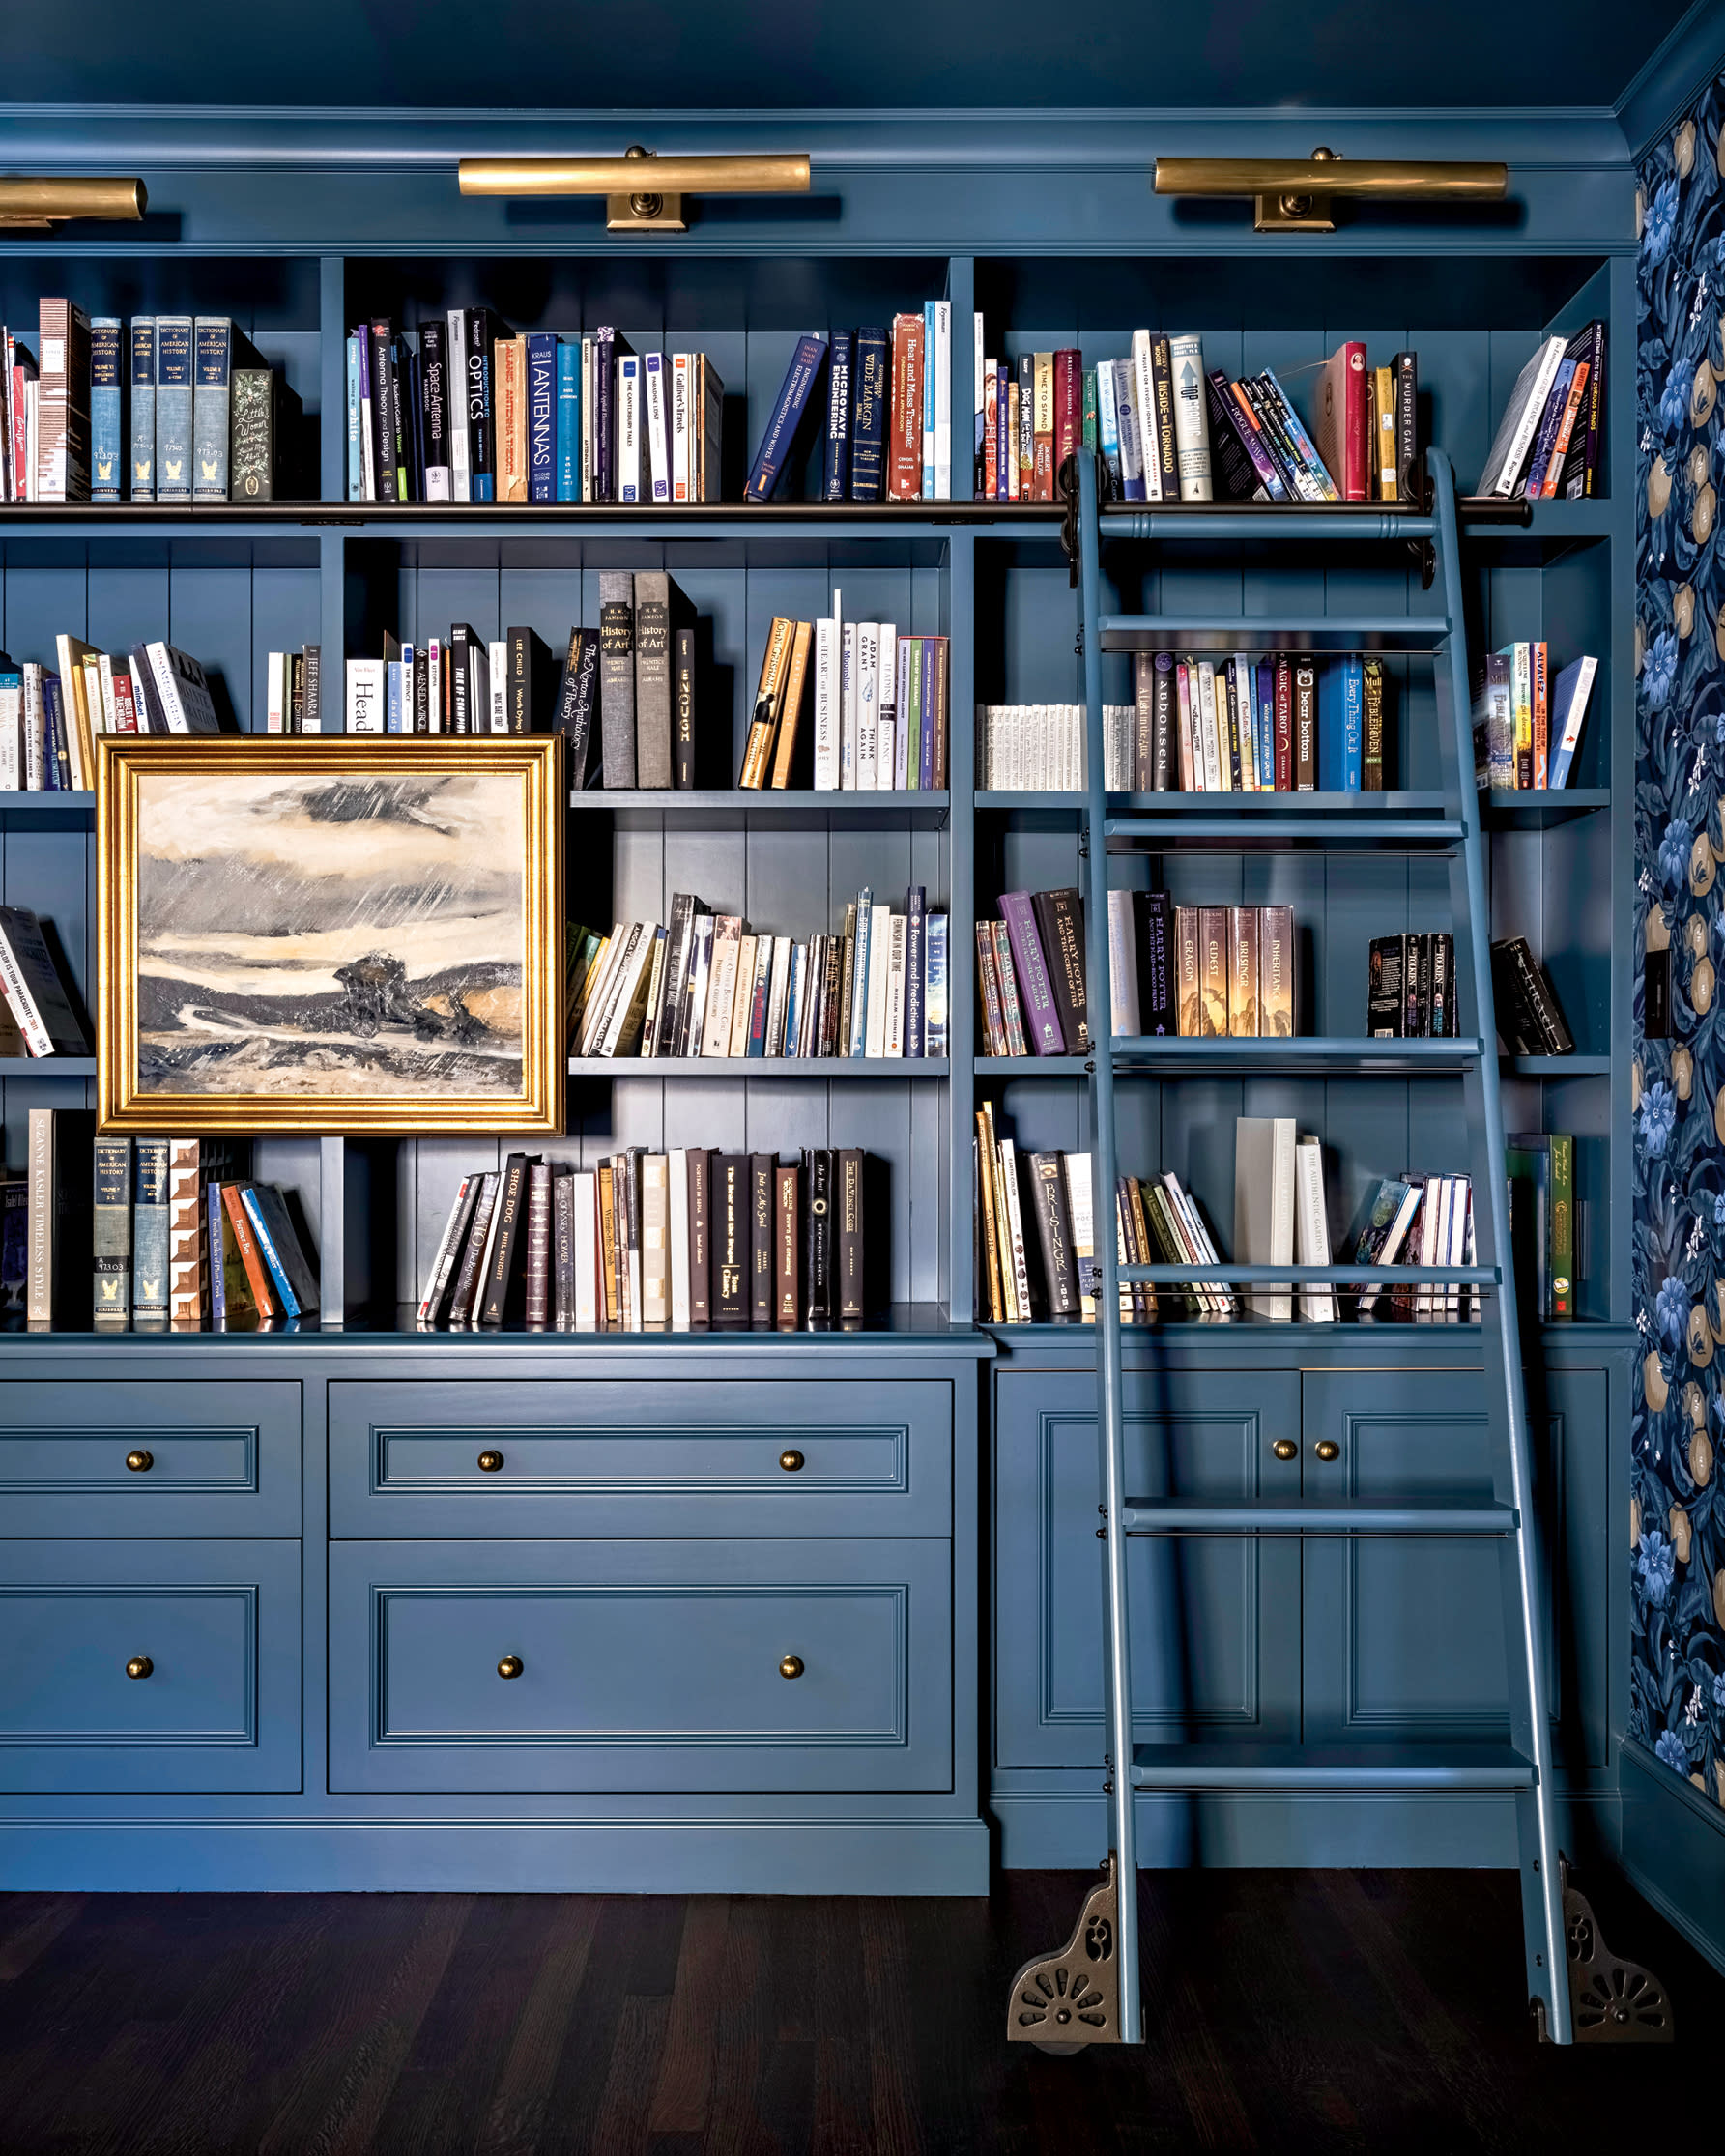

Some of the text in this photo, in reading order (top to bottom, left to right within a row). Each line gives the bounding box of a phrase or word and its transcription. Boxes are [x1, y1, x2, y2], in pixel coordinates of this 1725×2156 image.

[378, 346, 388, 385] Antenna
[532, 350, 552, 359] KRAUS
[427, 362, 443, 393] Space
[469, 355, 484, 420] OPTICS
[791, 367, 812, 409] ENGINEERING
[862, 353, 875, 431] WIDE MARGIN
[905, 338, 917, 448] Heat and Mass Transfer
[1157, 380, 1170, 414] INSIDE
[1576, 367, 1587, 387] CURTIS
[378, 386, 388, 416] Theory
[430, 394, 444, 439] Antenna
[483, 403, 491, 417] TO
[533, 367, 550, 465] ANTENNAS
[676, 372, 685, 434] Gulliver's Travels
[764, 364, 803, 459] ELECTROMAGNETICS AND WAVES
[830, 365, 840, 439] ENGINEERING
[838, 365, 848, 439] MICROWAVE
[1144, 387, 1153, 436] REVOLUTIONARIES
[235, 419, 269, 437] Women
[381, 431, 391, 462] Design
[1231, 406, 1253, 438] ROGUE
[1248, 437, 1266, 463] WAVE
[1161, 425, 1174, 474] TORNADO
[601, 625, 632, 641] History
[602, 638, 629, 649] of Art
[638, 637, 664, 648] of Art
[764, 620, 788, 687] JOHN GRISHAM
[306, 656, 319, 716] JEFF SHAARA
[564, 677, 579, 689] of
[820, 680, 827, 690] OF
[843, 650, 851, 691] Moonshot
[1365, 676, 1382, 687] Mull
[1537, 651, 1545, 693] ALVAREZ
[134, 685, 144, 716] mindset
[355, 681, 374, 733] Head
[389, 699, 399, 730] daddy
[494, 692, 503, 728] WHAT ARE YOU?
[561, 688, 577, 720] Poetry
[570, 643, 597, 751] The Norton Anthology
[679, 668, 691, 742] ENOUGH
[819, 693, 828, 742] BUSINESS
[515, 710, 524, 730] Dying
[1300, 691, 1311, 762] bear bottom
[1367, 697, 1382, 753] FABLEHAVEN
[892, 918, 904, 942] FEMINISM
[891, 949, 903, 961] OUR
[891, 961, 903, 972] TIME
[1024, 919, 1050, 1009] HARRY POTTER
[1064, 915, 1086, 1007] HARRY POTTER
[1155, 916, 1166, 1010] HARRY POTTER
[1185, 940, 1193, 982] ERAGON
[1209, 940, 1219, 977] ELDEST
[1239, 941, 1249, 987] BRISINGR
[1408, 955, 1417, 986] TOLKIEN
[1435, 951, 1445, 984] TOLKIEN
[909, 929, 920, 1030] Power and Prediction
[34, 1119, 45, 1299] SUZANNE KASLER TIMELESS STYLE
[503, 1167, 520, 1223] SHOE DOG
[235, 1219, 251, 1255] Farmer Boy
[462, 1201, 494, 1292] PLATO The Republic
[560, 1199, 570, 1265] ODYSSEY HOMER
[604, 1208, 615, 1267] Winnie-the-Pooh
[784, 1234, 792, 1246] girl
[495, 1231, 509, 1281] PHIL KNIGHT
[784, 1247, 792, 1276] dreaming
[722, 1268, 731, 1299] Clancy
[731, 1274, 739, 1293] Tom
